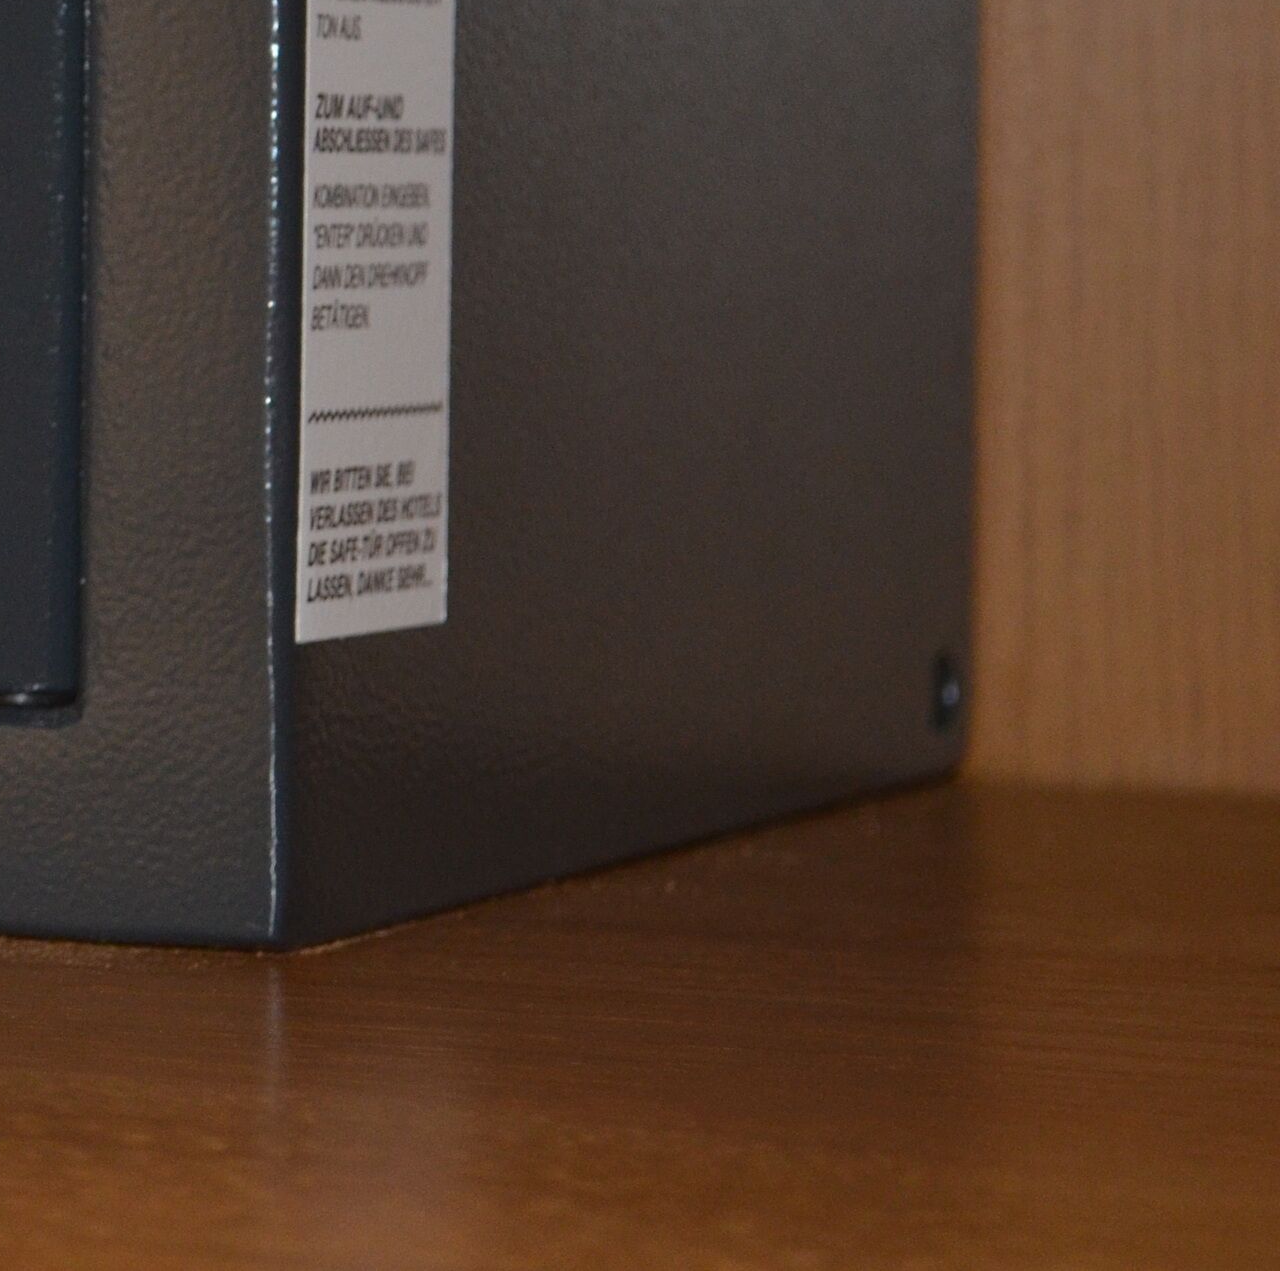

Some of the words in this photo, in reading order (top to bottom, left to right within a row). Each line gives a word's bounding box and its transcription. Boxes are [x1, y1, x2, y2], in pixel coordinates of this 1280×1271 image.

[317, 14, 337, 39] TON
[315, 94, 343, 119] ZUM
[314, 127, 390, 152] ABSCHLIESSEN
[394, 128, 412, 153] DES
[314, 184, 379, 208] KOMBINATION
[313, 265, 341, 289] DANN
[344, 264, 364, 289] DEN
[310, 469, 331, 494] WIR
[334, 465, 372, 491] BITTEN
[310, 500, 373, 530] VERLASSEN
[376, 498, 398, 524] DES
[401, 493, 442, 518] HOTELS
[308, 541, 327, 566] DIE
[386, 529, 419, 556] OFFEN
[357, 566, 394, 594] DANKE
